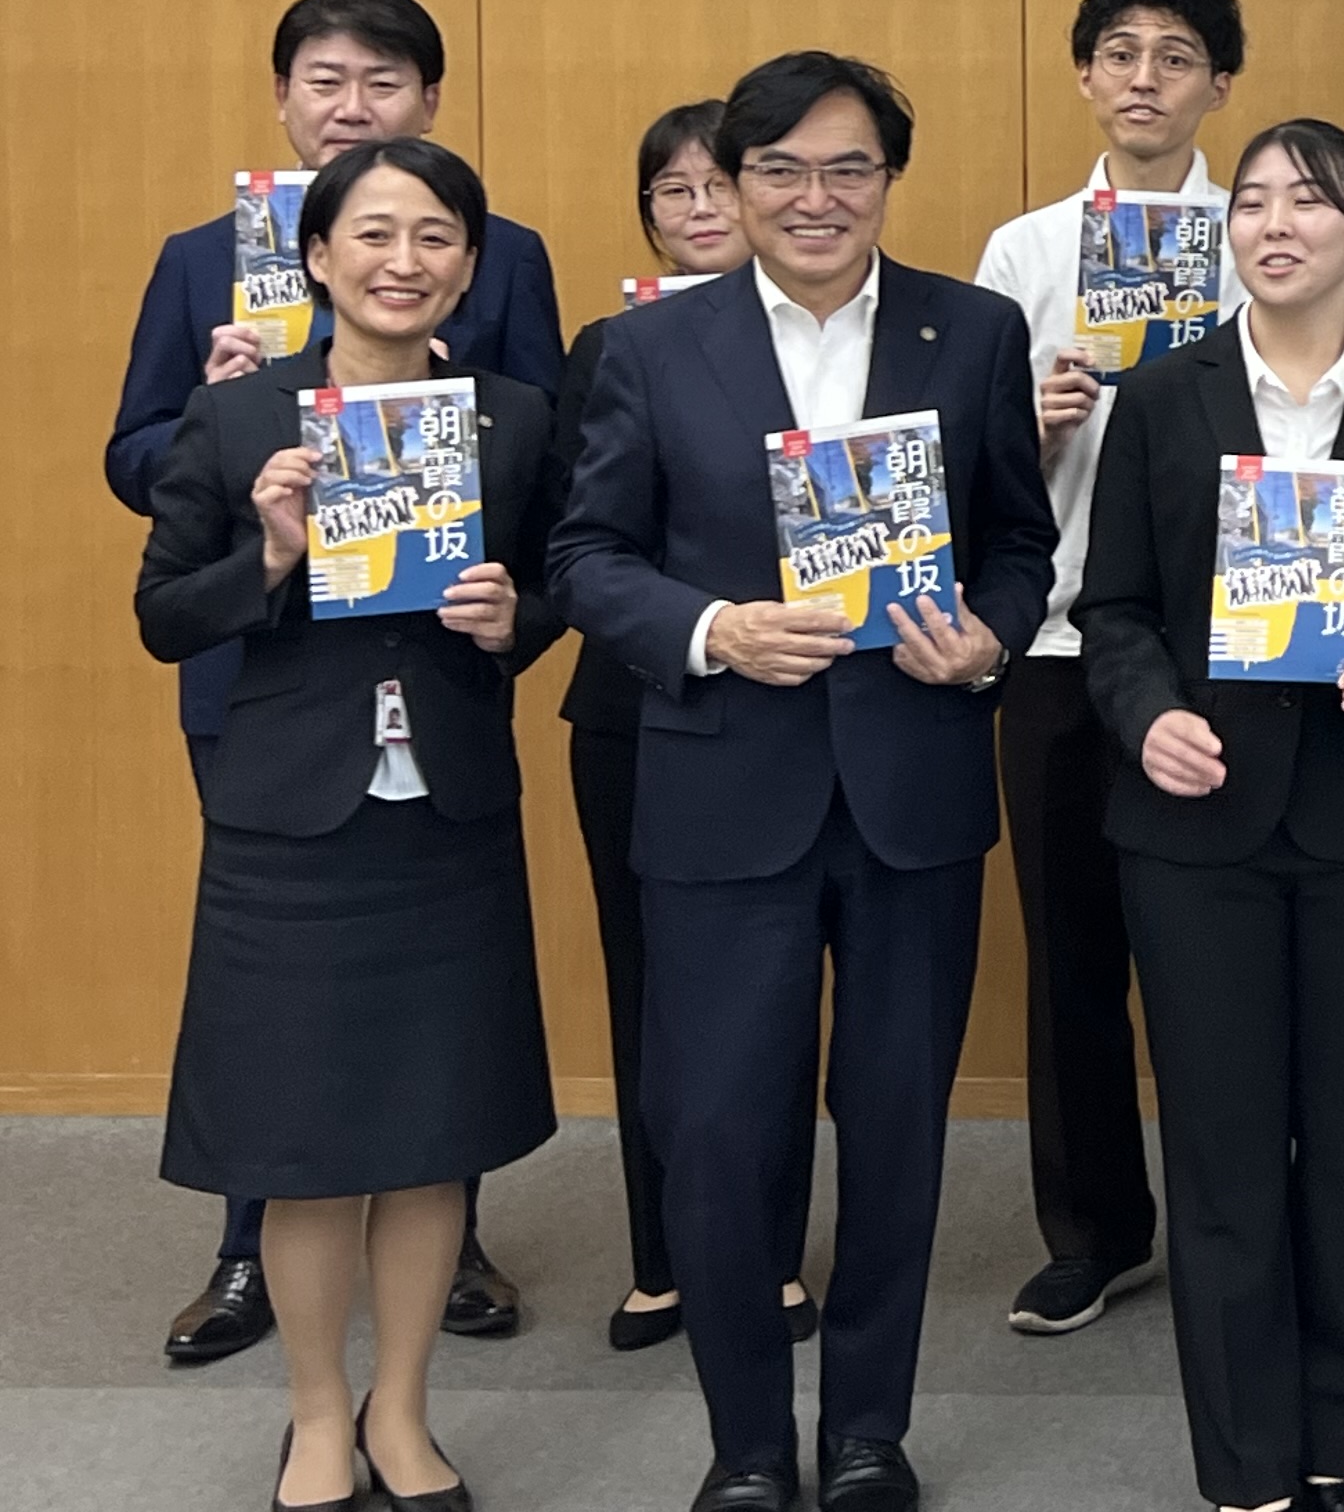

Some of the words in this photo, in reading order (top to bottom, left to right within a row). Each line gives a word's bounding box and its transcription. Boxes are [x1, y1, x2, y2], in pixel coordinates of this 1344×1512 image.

[419, 405, 469, 563] 朝霞の坂
[886, 439, 942, 597] 朝霞の坂
